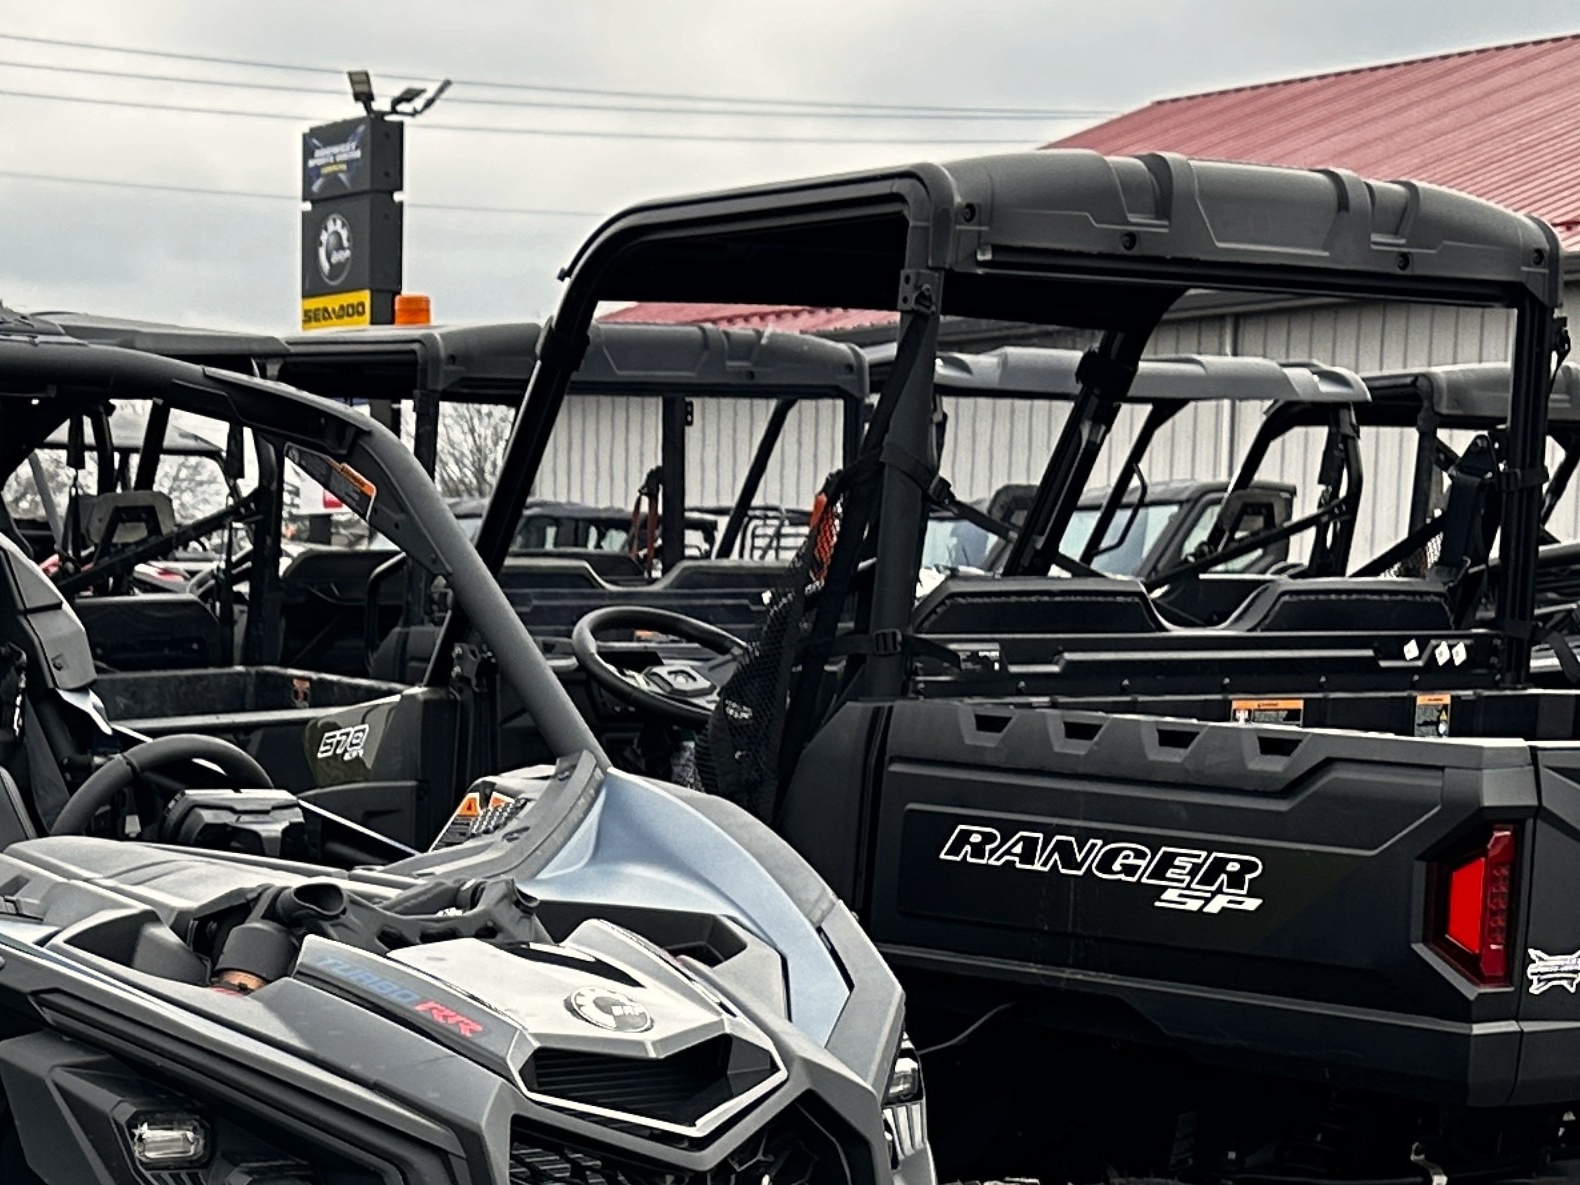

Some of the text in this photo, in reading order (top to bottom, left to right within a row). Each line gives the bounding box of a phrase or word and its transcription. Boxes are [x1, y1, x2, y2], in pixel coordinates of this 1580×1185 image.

[939, 824, 1263, 895] RANGER
[1154, 888, 1264, 913] SP
[318, 956, 484, 1037] TURBO RR
